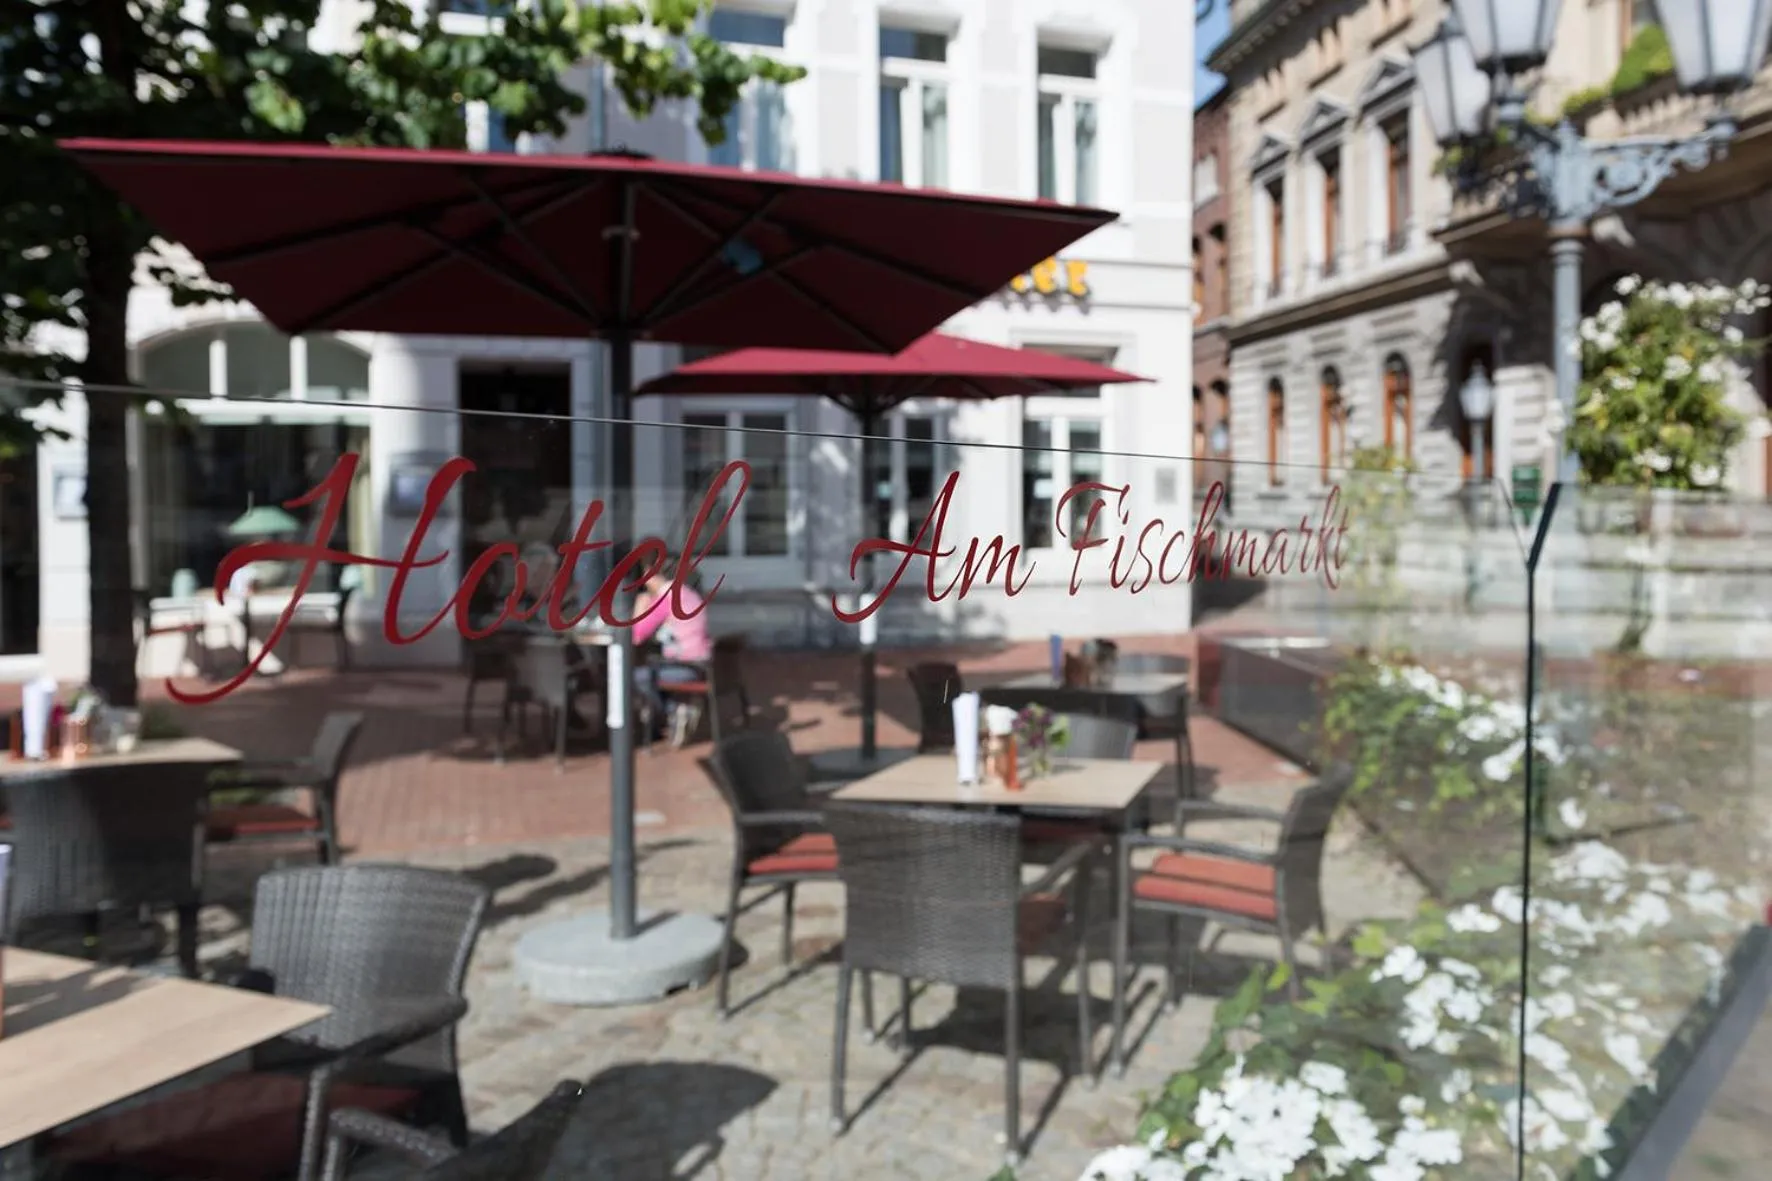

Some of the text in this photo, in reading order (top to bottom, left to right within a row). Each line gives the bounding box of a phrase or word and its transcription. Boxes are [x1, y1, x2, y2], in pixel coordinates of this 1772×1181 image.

[165, 452, 1349, 704] Hotel Am Fischmarkt
